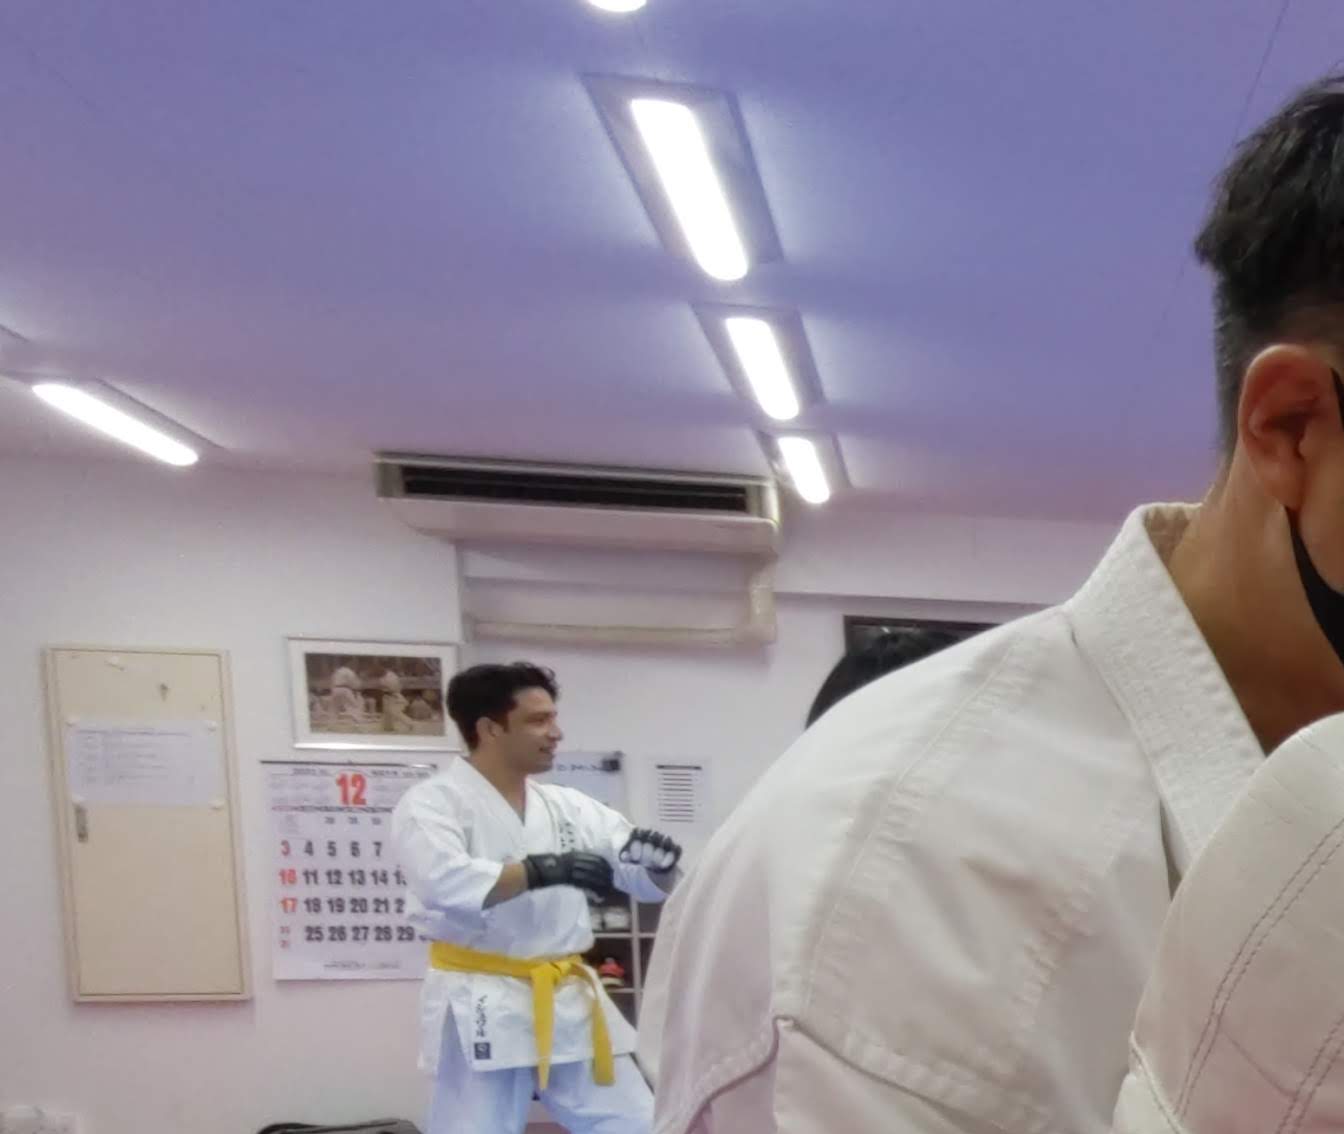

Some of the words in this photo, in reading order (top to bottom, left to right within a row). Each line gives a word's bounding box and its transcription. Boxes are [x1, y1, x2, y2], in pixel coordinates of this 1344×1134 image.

[336, 773, 367, 806] 12
[281, 840, 290, 857] 3
[304, 841, 314, 857] 4
[327, 841, 337, 857] 5
[350, 841, 360, 857] 6
[373, 841, 382, 857] 7
[279, 869, 297, 885] 10
[303, 870, 318, 885] 11
[326, 870, 342, 885] 12
[348, 870, 365, 885] 13
[371, 870, 388, 885] 14
[281, 898, 297, 913] 17
[304, 898, 321, 913] 18
[327, 898, 345, 913] 19
[350, 898, 368, 913] 20
[373, 898, 389, 913] 21
[305, 926, 324, 942] 25
[328, 926, 346, 942] 26
[352, 926, 369, 942] 27
[374, 926, 392, 942] 28
[397, 926, 415, 942] 29
